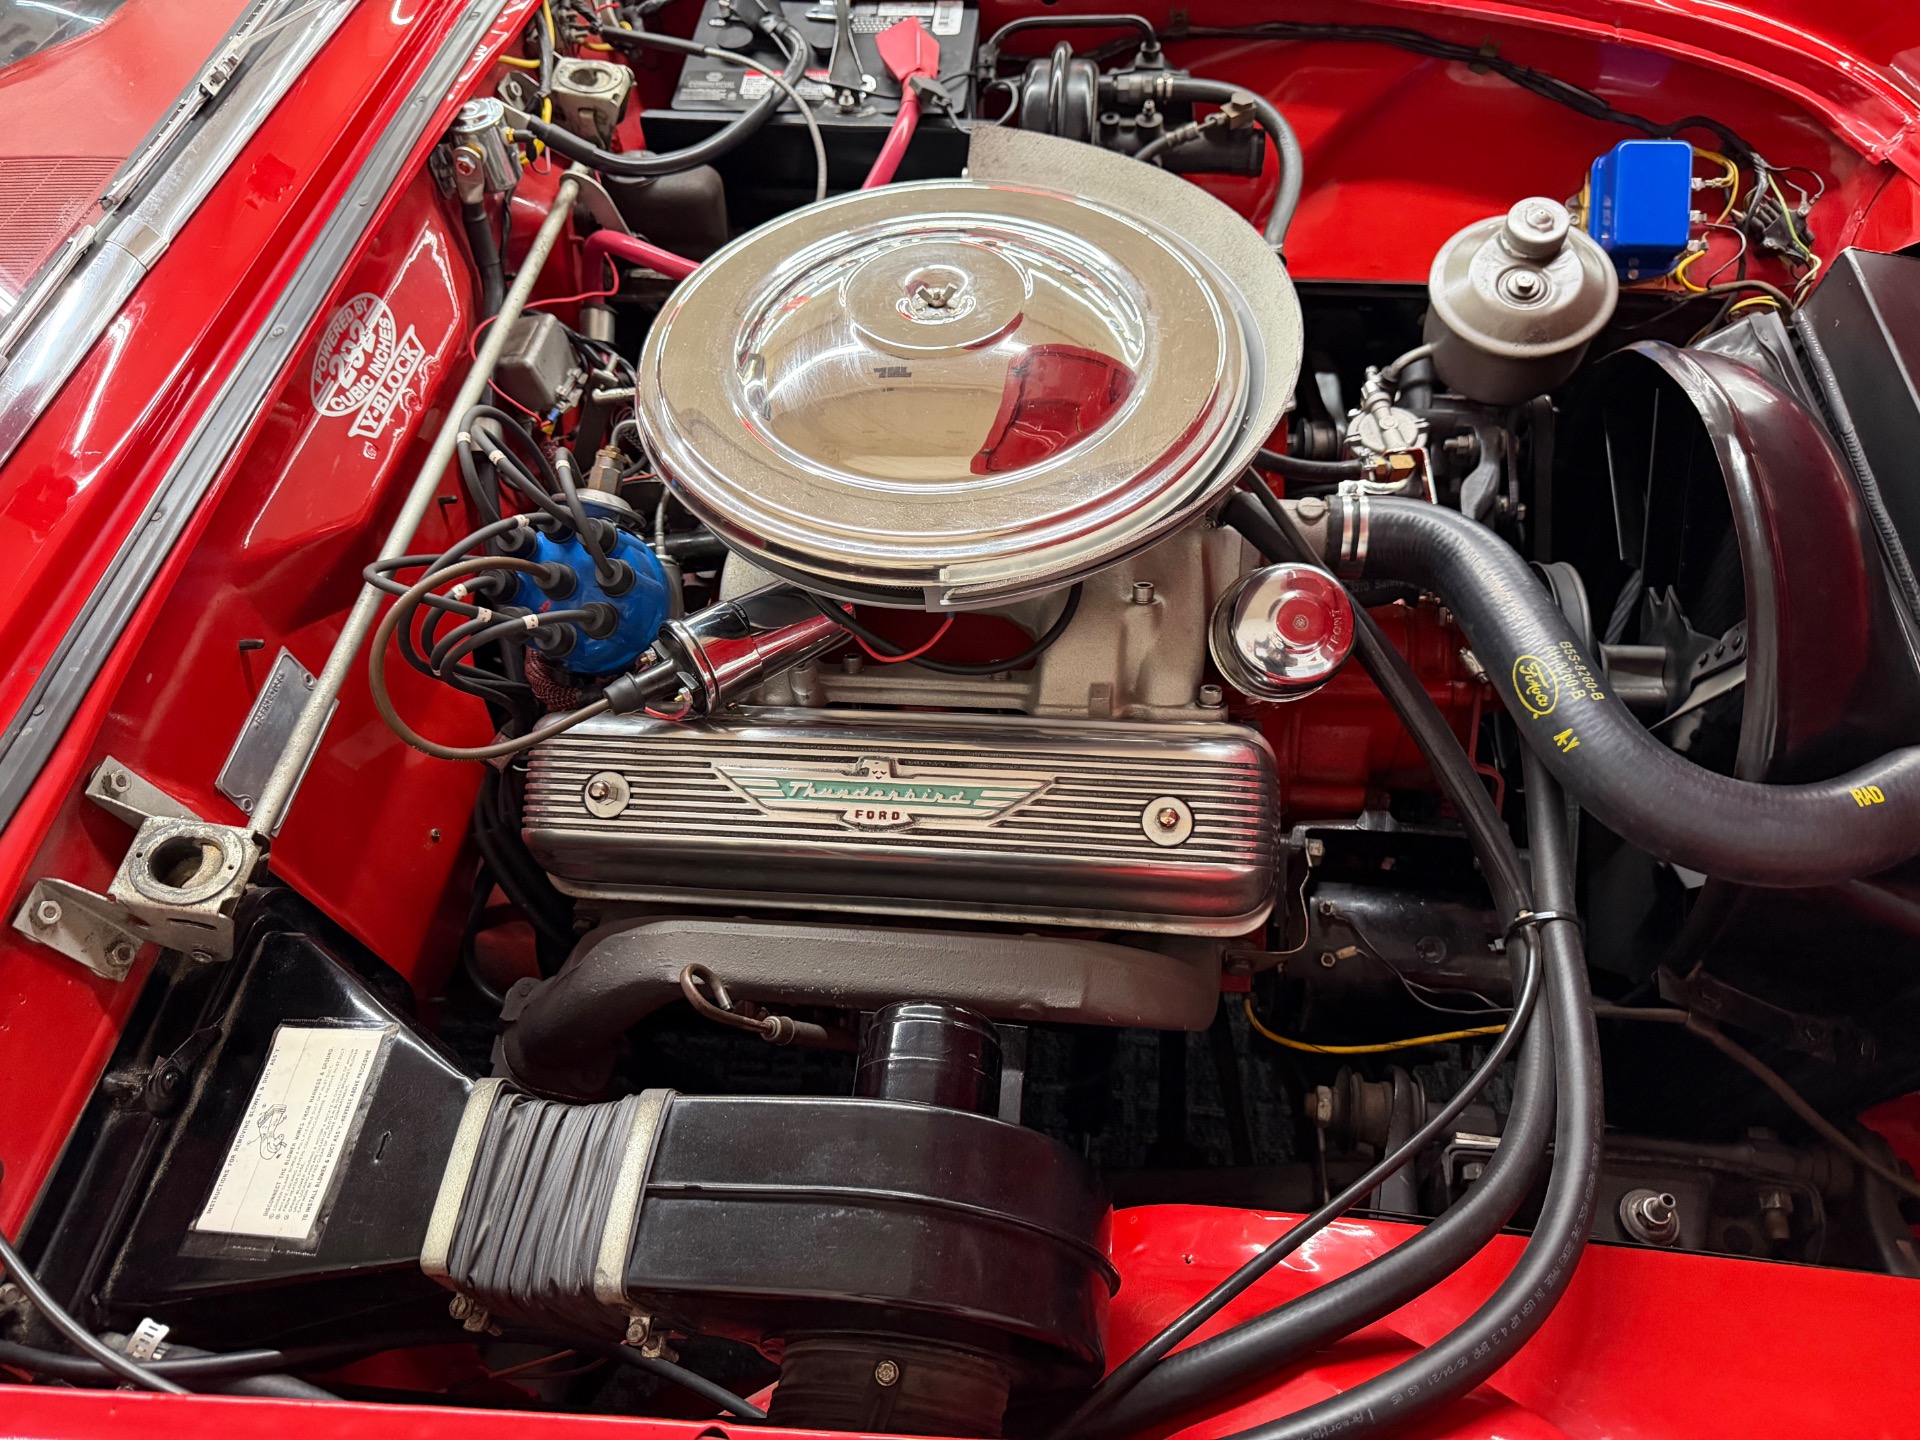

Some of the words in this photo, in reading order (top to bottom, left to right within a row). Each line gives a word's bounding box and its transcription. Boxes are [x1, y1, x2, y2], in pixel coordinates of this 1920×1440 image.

[314, 309, 354, 384] POWERED
[354, 299, 368, 316] BY
[329, 319, 377, 389] 292
[330, 375, 375, 411] CUBIC
[368, 317, 391, 377] INCHES
[360, 343, 419, 429] Y-BLOCK
[1326, 609, 1342, 652] FRONT
[1559, 641, 1605, 700] B5S-8260-B
[788, 782, 971, 804] Thunderbird
[855, 810, 900, 821] FORD
[1849, 785, 1885, 807] RAD
[205, 1169, 230, 1213] INSTRUCTIONS
[227, 1154, 236, 1166] FOR
[233, 1119, 251, 1150] REMOVING
[248, 1093, 262, 1116] BLOWER
[261, 1068, 272, 1083] DUCT
[262, 1182, 281, 1216] DISCONNECT
[278, 1168, 286, 1178] THE
[283, 1142, 297, 1165] BLOWER
[293, 1122, 305, 1140] WIRES
[302, 1105, 311, 1119] FROM
[300, 1213, 308, 1221] TO
[304, 1188, 318, 1212] INSTALL
[314, 1164, 328, 1187] BLOWER
[325, 1144, 336, 1157] DUCT
[348, 1079, 360, 1096] ABOVE
[355, 1048, 372, 1078] PROCEDURE
[1297, 1411, 1363, 1440] ArmorMar
